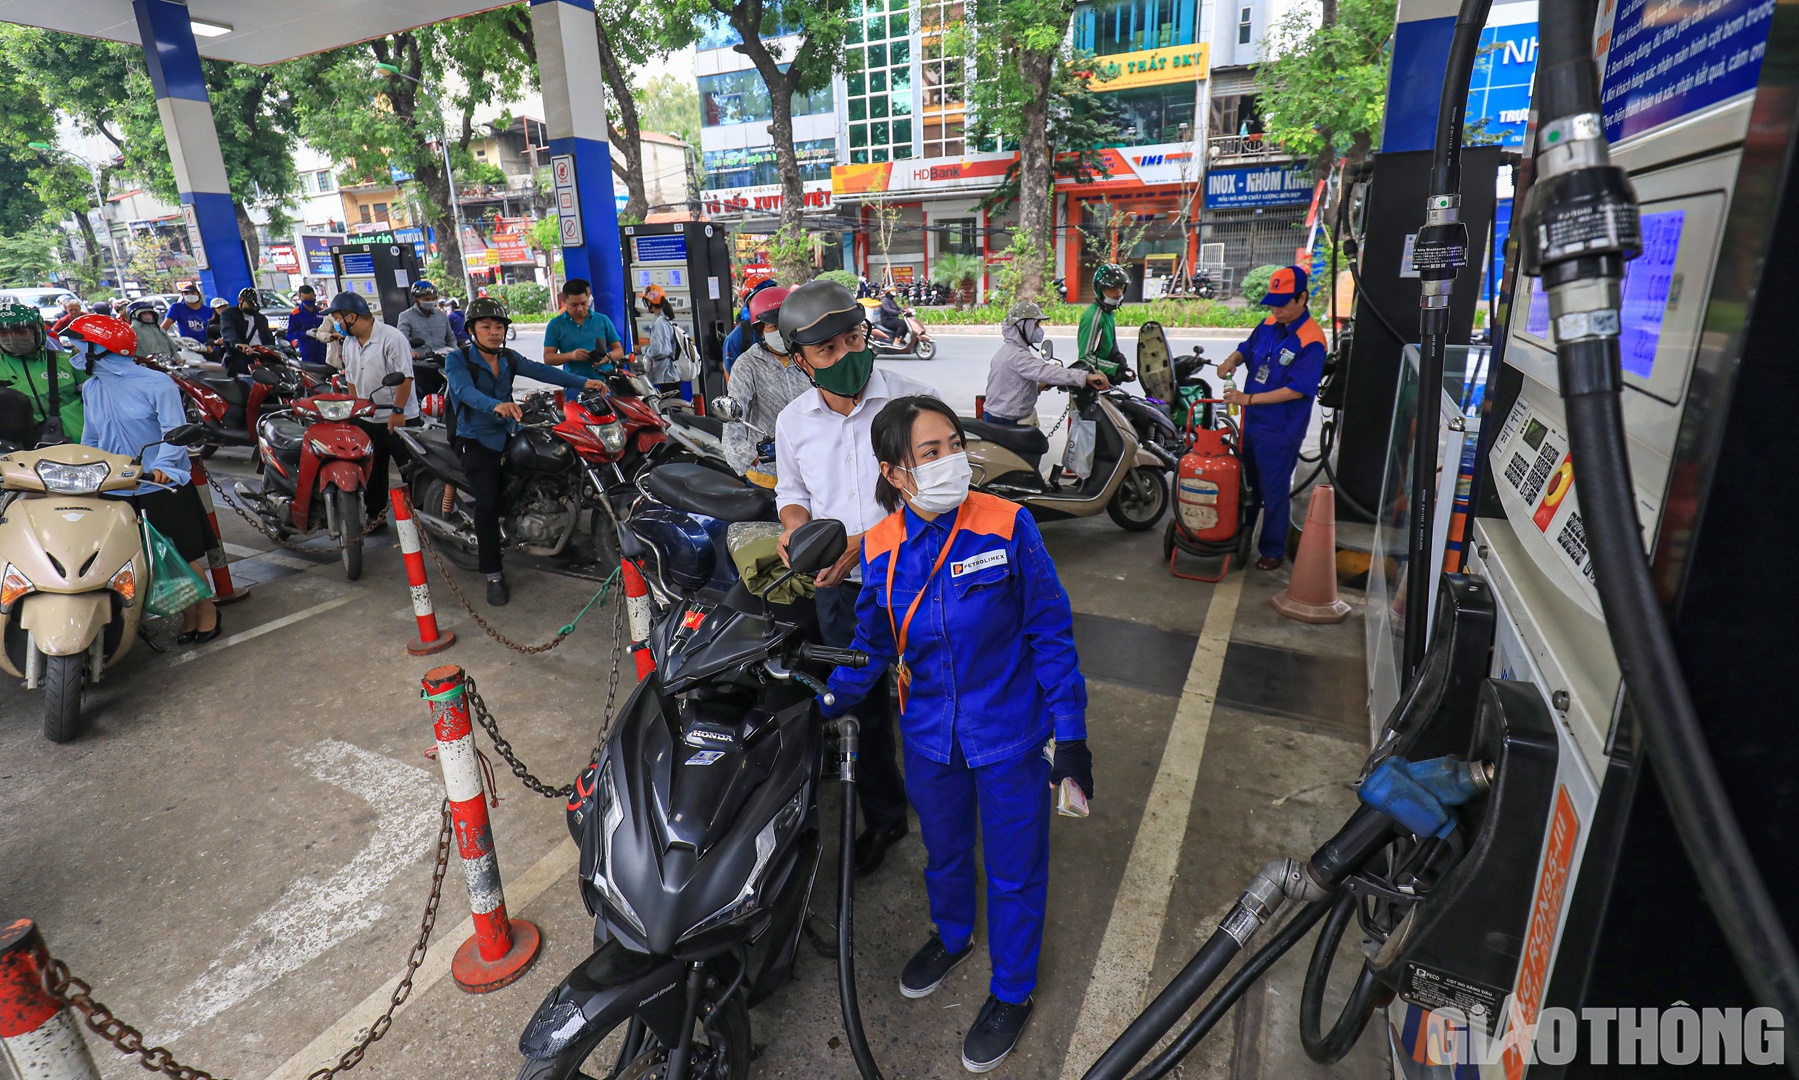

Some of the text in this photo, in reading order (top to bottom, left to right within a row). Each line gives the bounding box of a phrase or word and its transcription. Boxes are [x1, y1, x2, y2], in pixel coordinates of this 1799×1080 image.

[1128, 52, 1167, 74] THẤT
[1173, 52, 1203, 68] SKY
[1141, 155, 1164, 167] EMS
[913, 166, 960, 181] HDBank
[1208, 174, 1237, 196] INOX
[1246, 168, 1282, 193] NHÔM
[705, 194, 721, 215] TỦ
[724, 193, 749, 213] BẾP
[754, 195, 784, 211] XUY
[803, 187, 832, 208] VIỆT
[41, 370, 70, 380] Gab
[963, 553, 1006, 570] PETROLIMEX
[691, 729, 734, 743] HONDA
[1426, 972, 1440, 981] PECO
[639, 982, 677, 1008] Combi Brake
